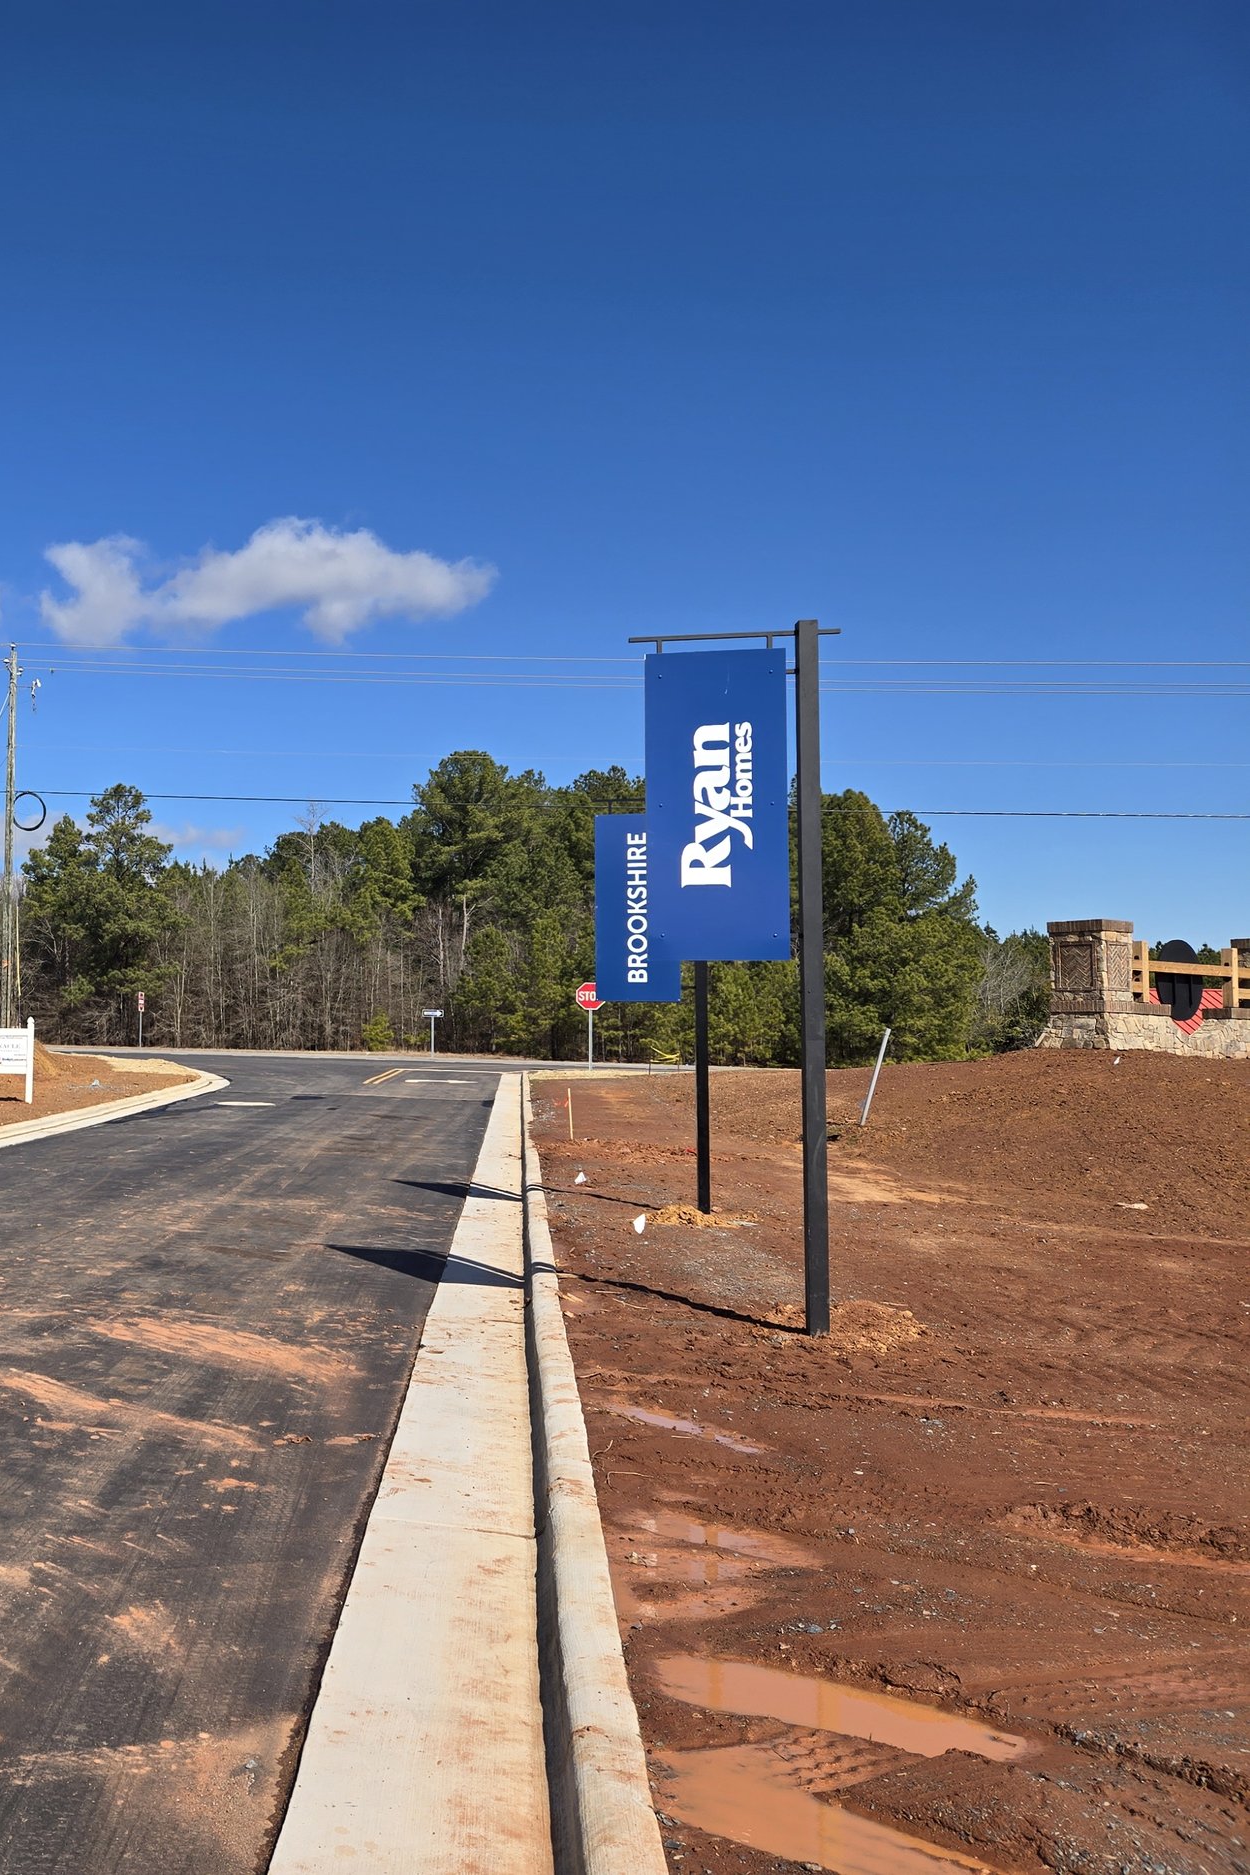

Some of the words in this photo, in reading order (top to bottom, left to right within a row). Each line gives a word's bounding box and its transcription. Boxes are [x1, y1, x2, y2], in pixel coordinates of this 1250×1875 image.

[681, 721, 753, 889] Ryan
[731, 721, 753, 818] Homes
[627, 832, 648, 983] BROOKSHIRE
[578, 991, 597, 1002] STO
